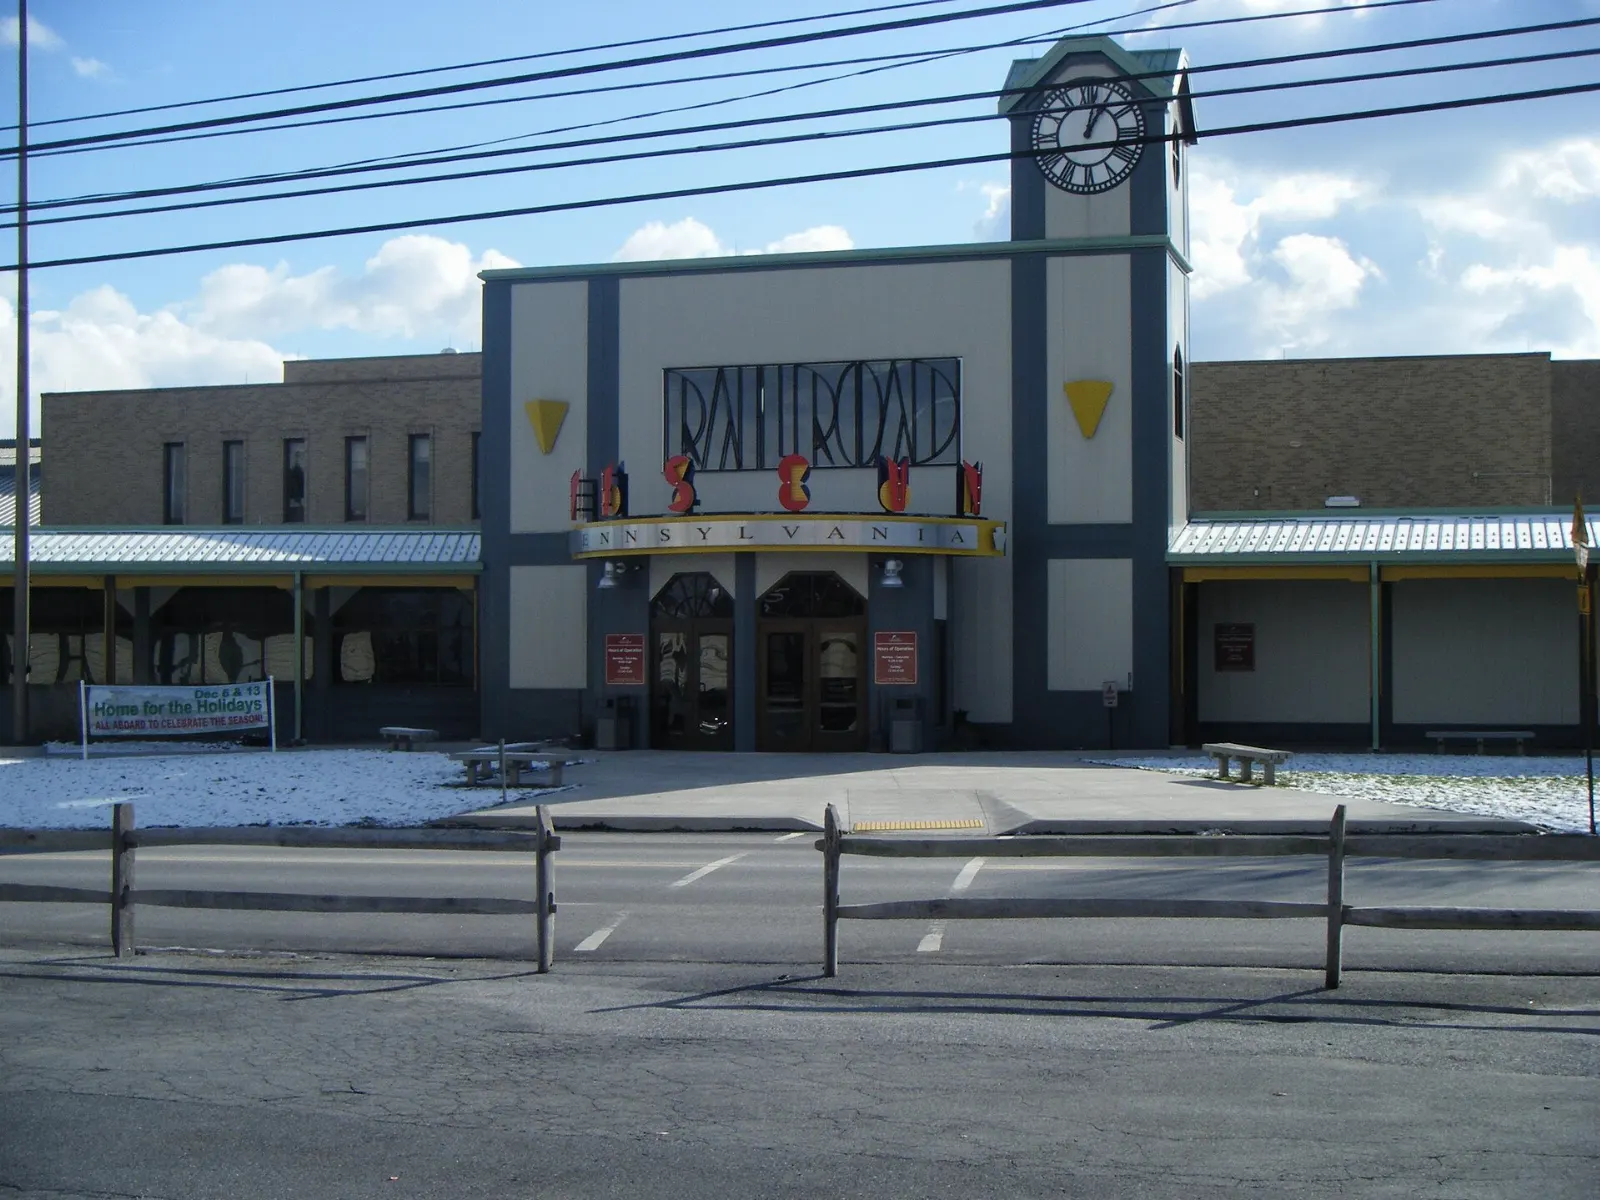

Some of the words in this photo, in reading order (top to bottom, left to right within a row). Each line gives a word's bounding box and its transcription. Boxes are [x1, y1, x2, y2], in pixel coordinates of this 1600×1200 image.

[663, 357, 961, 471] RAILROAD
[194, 689, 218, 699] Dec
[233, 687, 242, 697] &
[246, 685, 260, 696] 13
[94, 702, 139, 717] Home
[143, 700, 165, 716] for
[168, 700, 192, 715] the
[197, 697, 262, 715] Holidays
[95, 720, 110, 730] ALL
[113, 720, 146, 730] ABOARD
[148, 719, 159, 729] TO
[161, 717, 208, 729] CELEBRATE
[211, 716, 226, 726] THE
[228, 713, 263, 725] SEASON!
